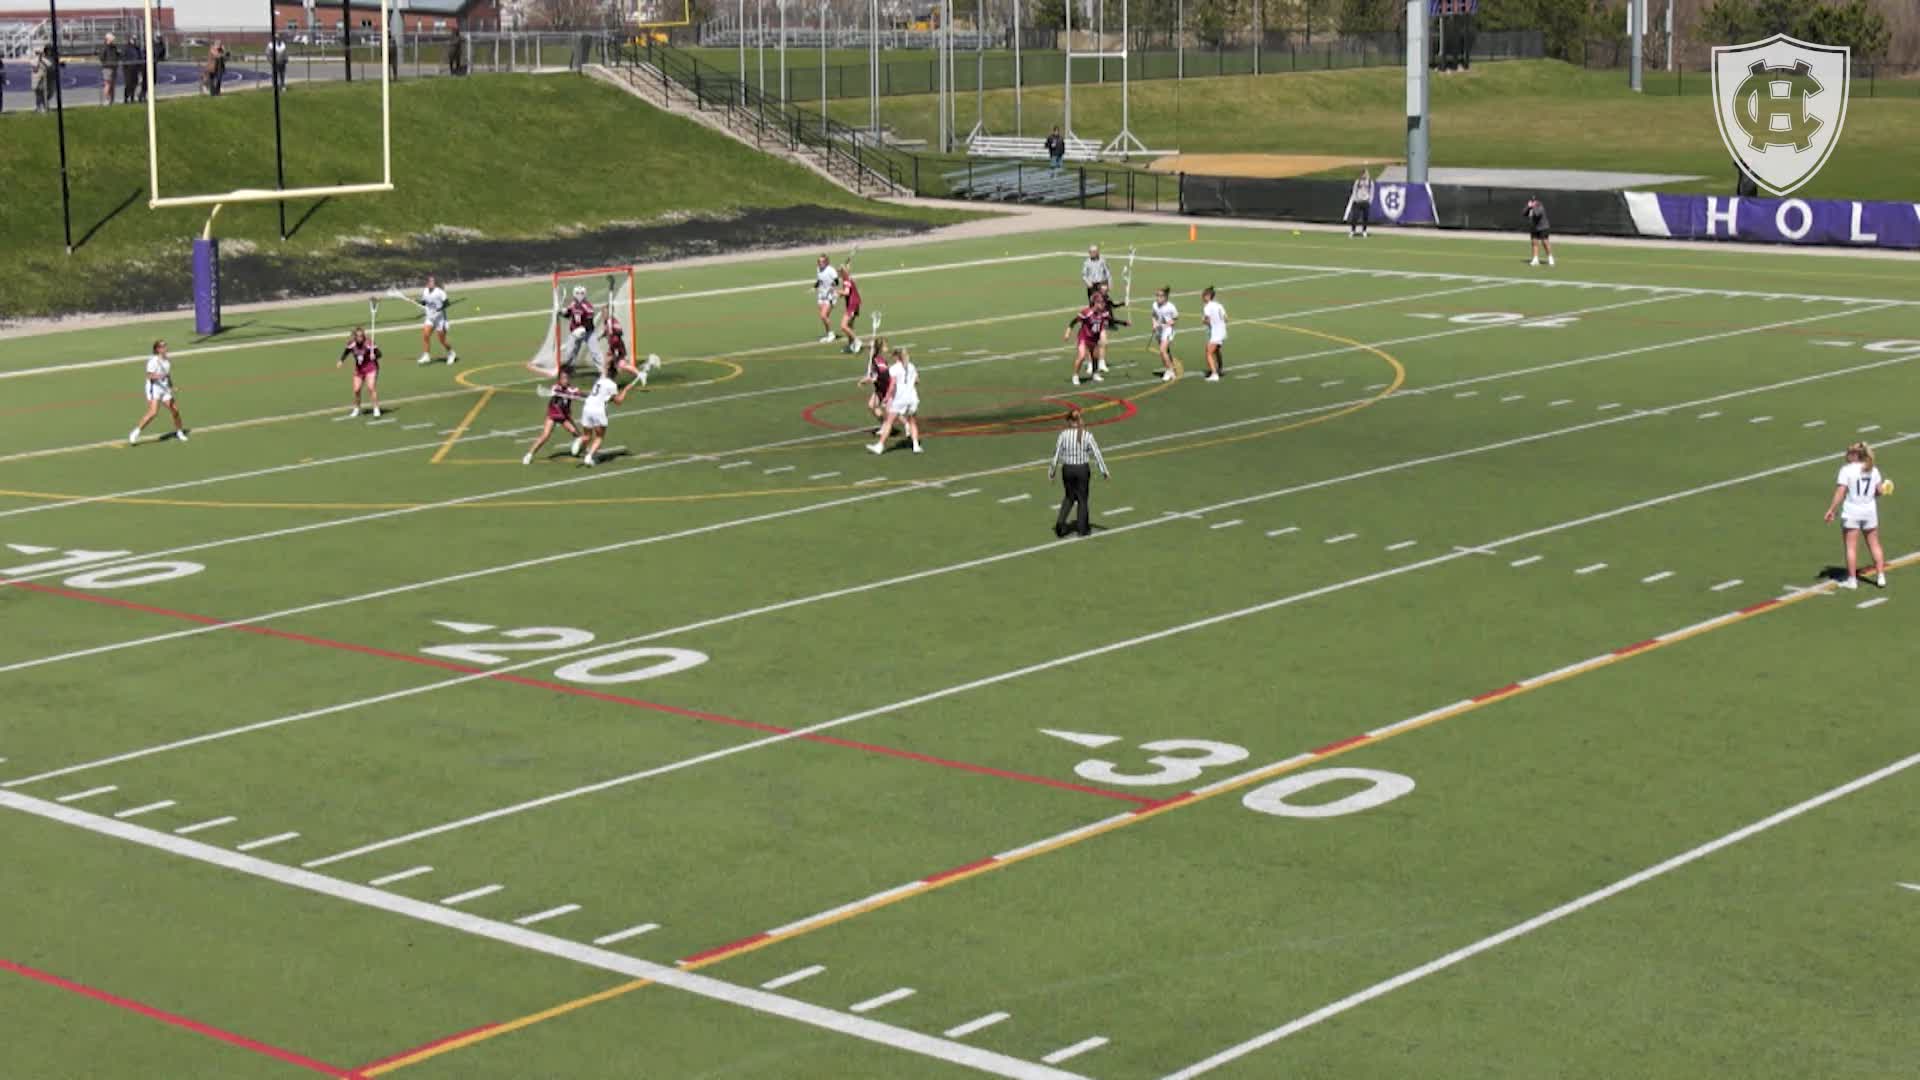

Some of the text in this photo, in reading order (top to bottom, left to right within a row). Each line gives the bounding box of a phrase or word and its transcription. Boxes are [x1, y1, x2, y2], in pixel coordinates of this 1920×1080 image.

[1706, 196, 1920, 242] HOL
[1856, 477, 1871, 496] 17
[0, 549, 206, 589] 10
[419, 626, 710, 684] 20
[1073, 739, 1416, 817] 30
